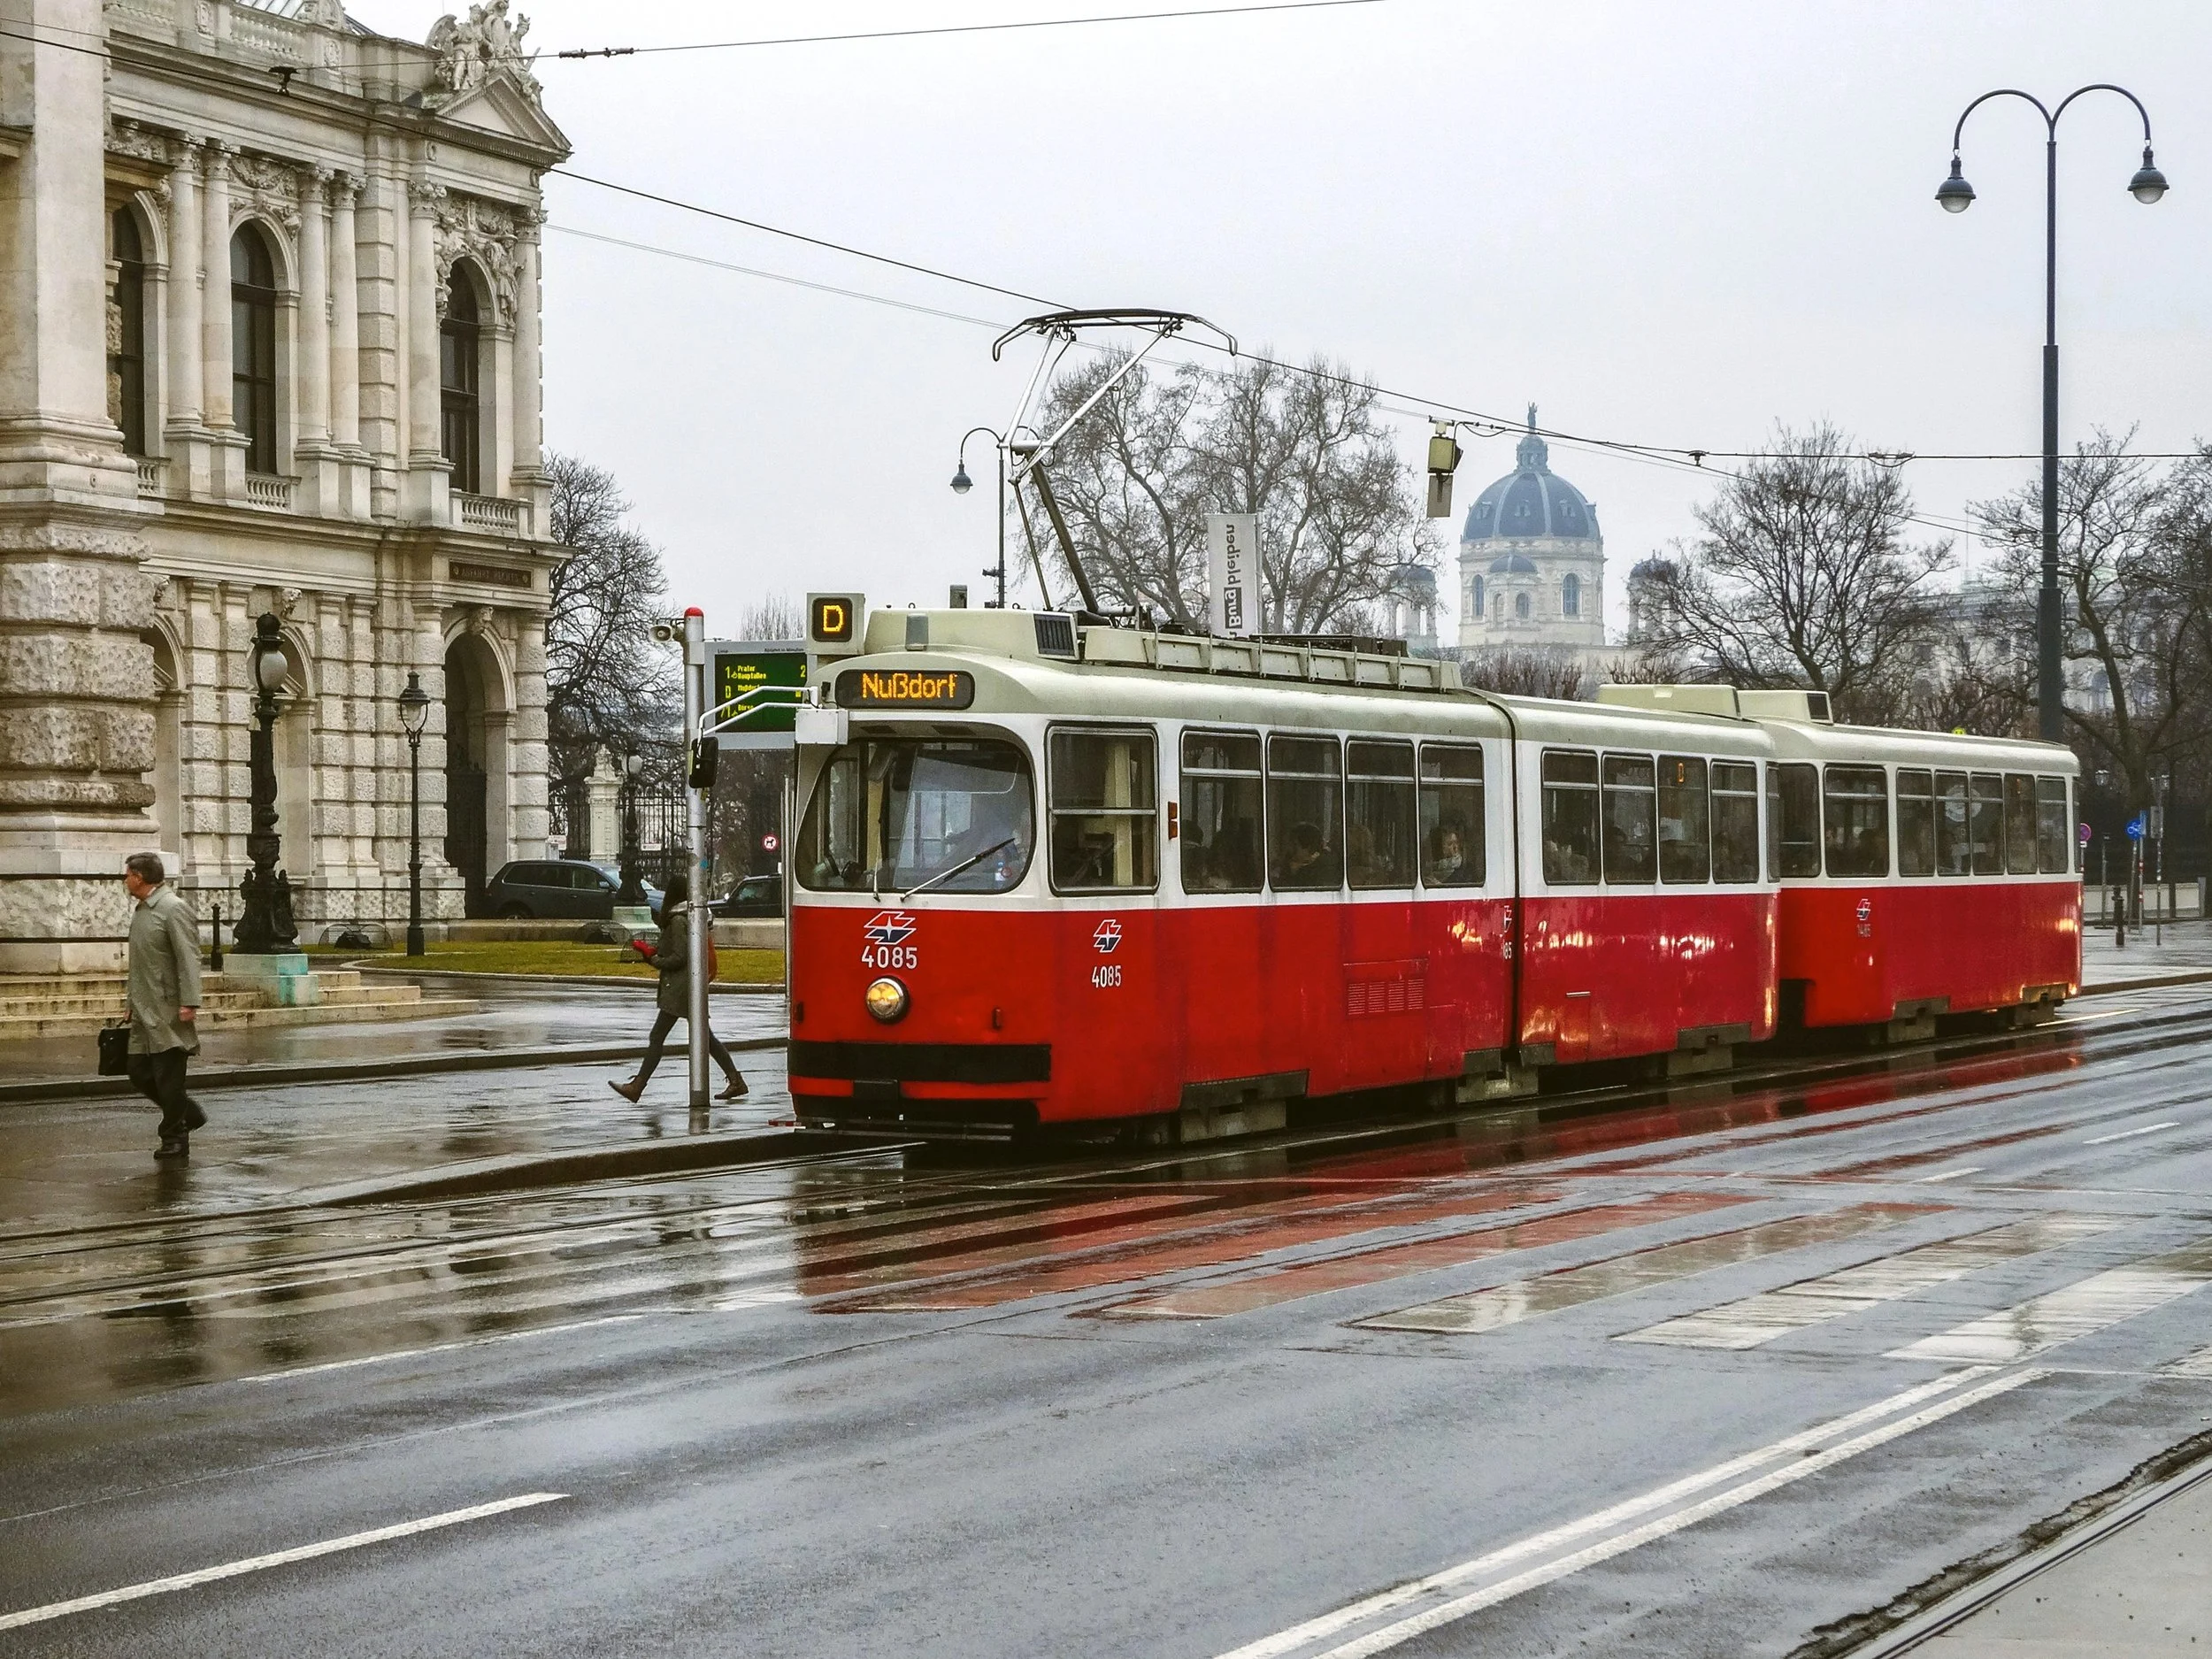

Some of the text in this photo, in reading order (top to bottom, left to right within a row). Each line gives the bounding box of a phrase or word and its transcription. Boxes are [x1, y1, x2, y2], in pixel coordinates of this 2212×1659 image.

[823, 604, 844, 633] D
[726, 666, 730, 679] 1
[801, 664, 806, 678] 2
[861, 672, 957, 699] Nußdorf
[861, 945, 918, 970] 4085
[1091, 965, 1122, 988] 4085
